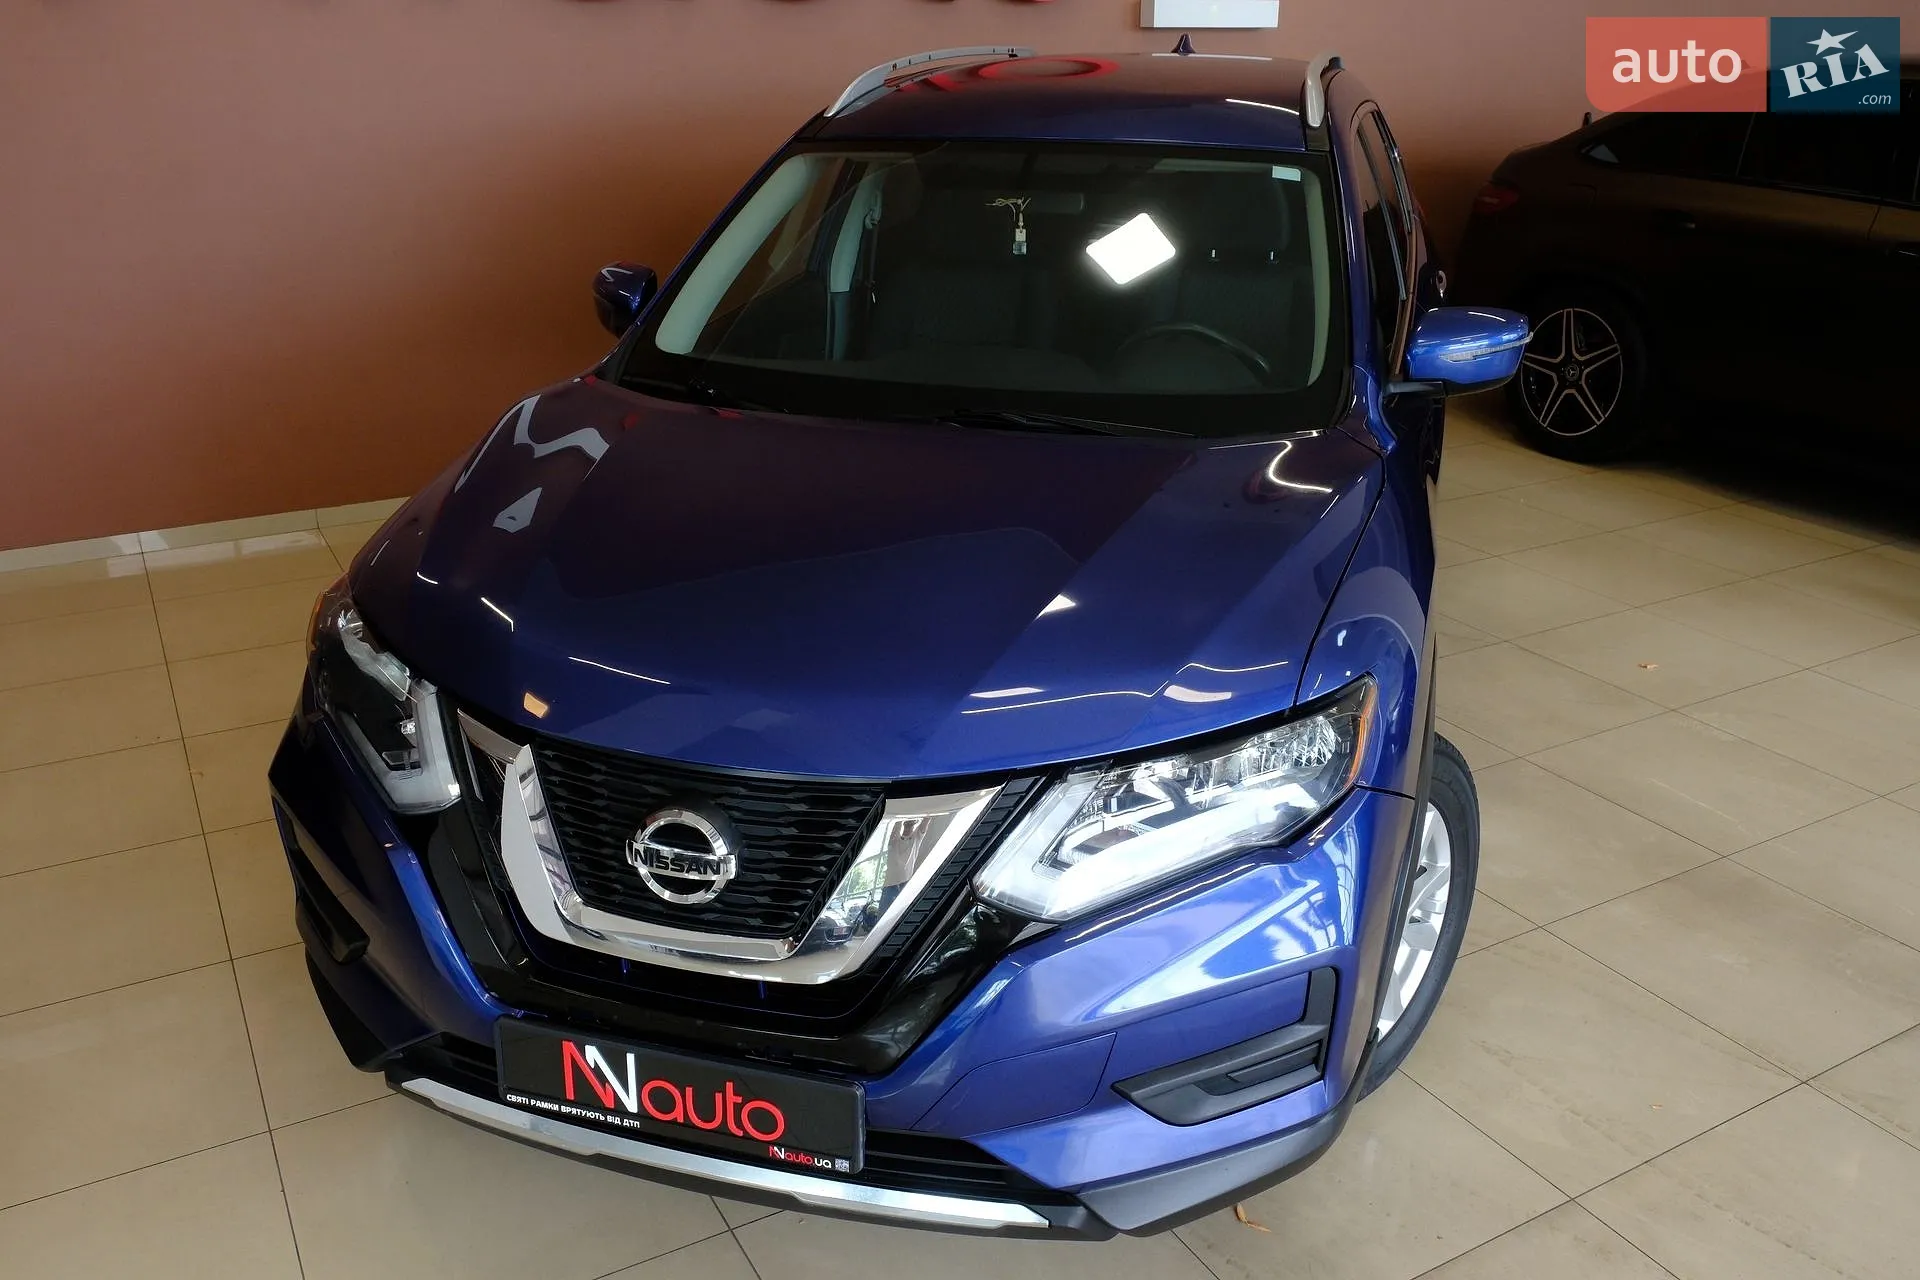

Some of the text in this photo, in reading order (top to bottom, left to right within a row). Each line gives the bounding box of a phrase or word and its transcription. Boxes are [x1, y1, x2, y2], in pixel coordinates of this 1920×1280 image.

[633, 845, 721, 876] NISSAN
[506, 1094, 641, 1129] СВЯТІ РАМКИ ВРЯТУЮТЬ ВІД ДТП
